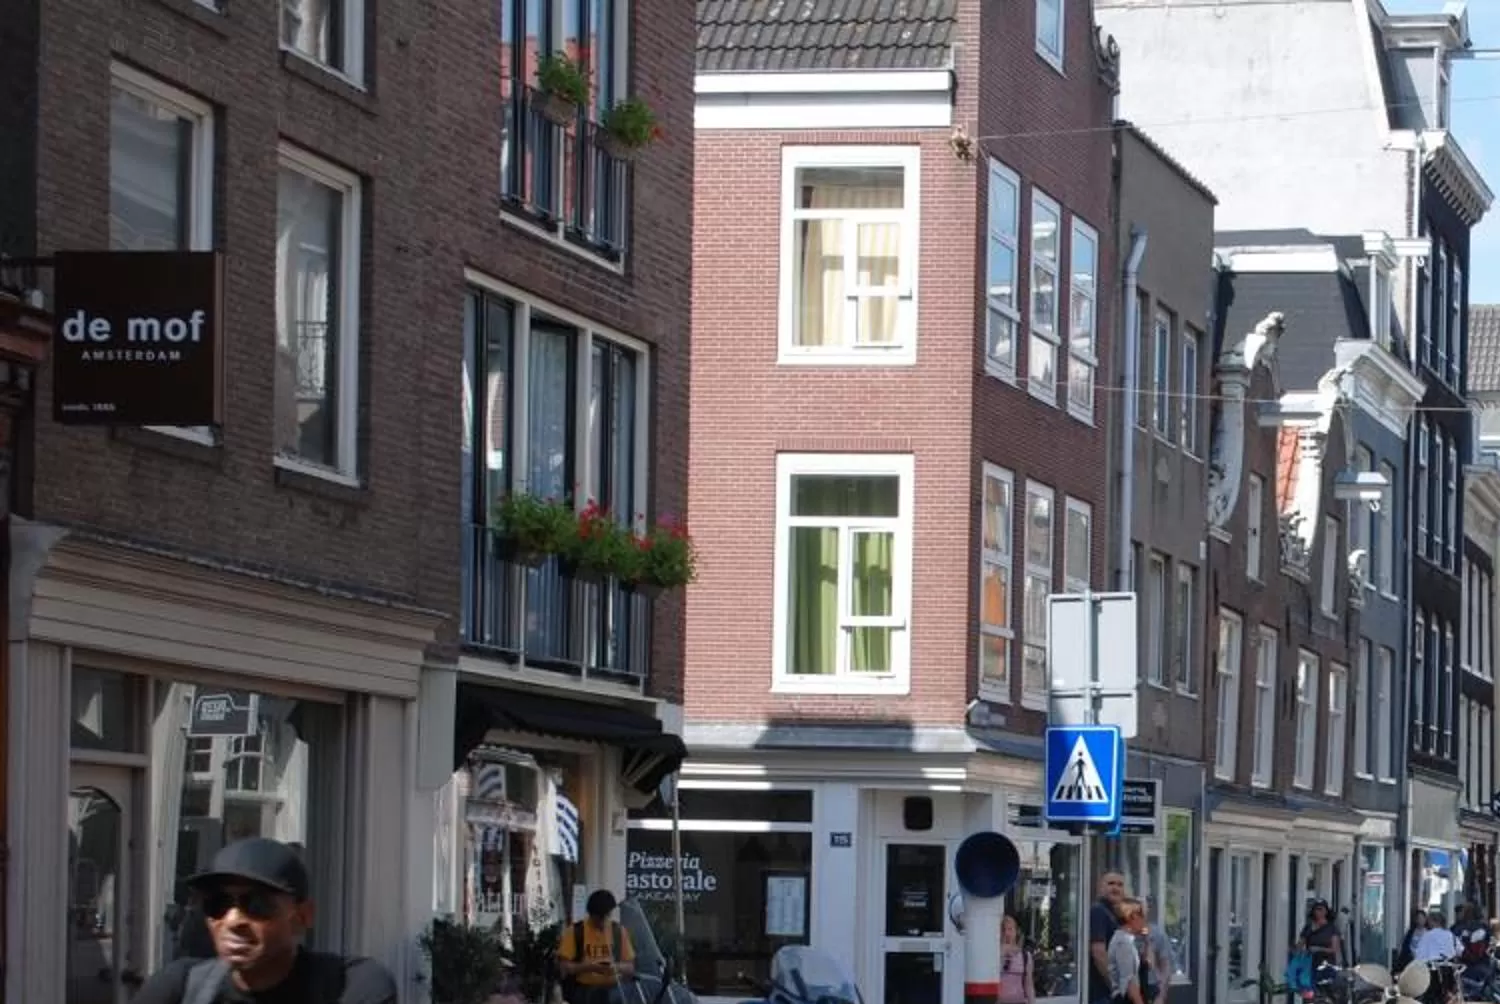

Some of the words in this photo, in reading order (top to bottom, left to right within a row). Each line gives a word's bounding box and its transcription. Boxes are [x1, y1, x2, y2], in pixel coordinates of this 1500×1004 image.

[62, 309, 112, 342] de
[127, 309, 205, 342] mof
[81, 350, 181, 361] AMSTERDAM
[628, 851, 701, 869] Pizzeia
[627, 869, 717, 891] astoale
